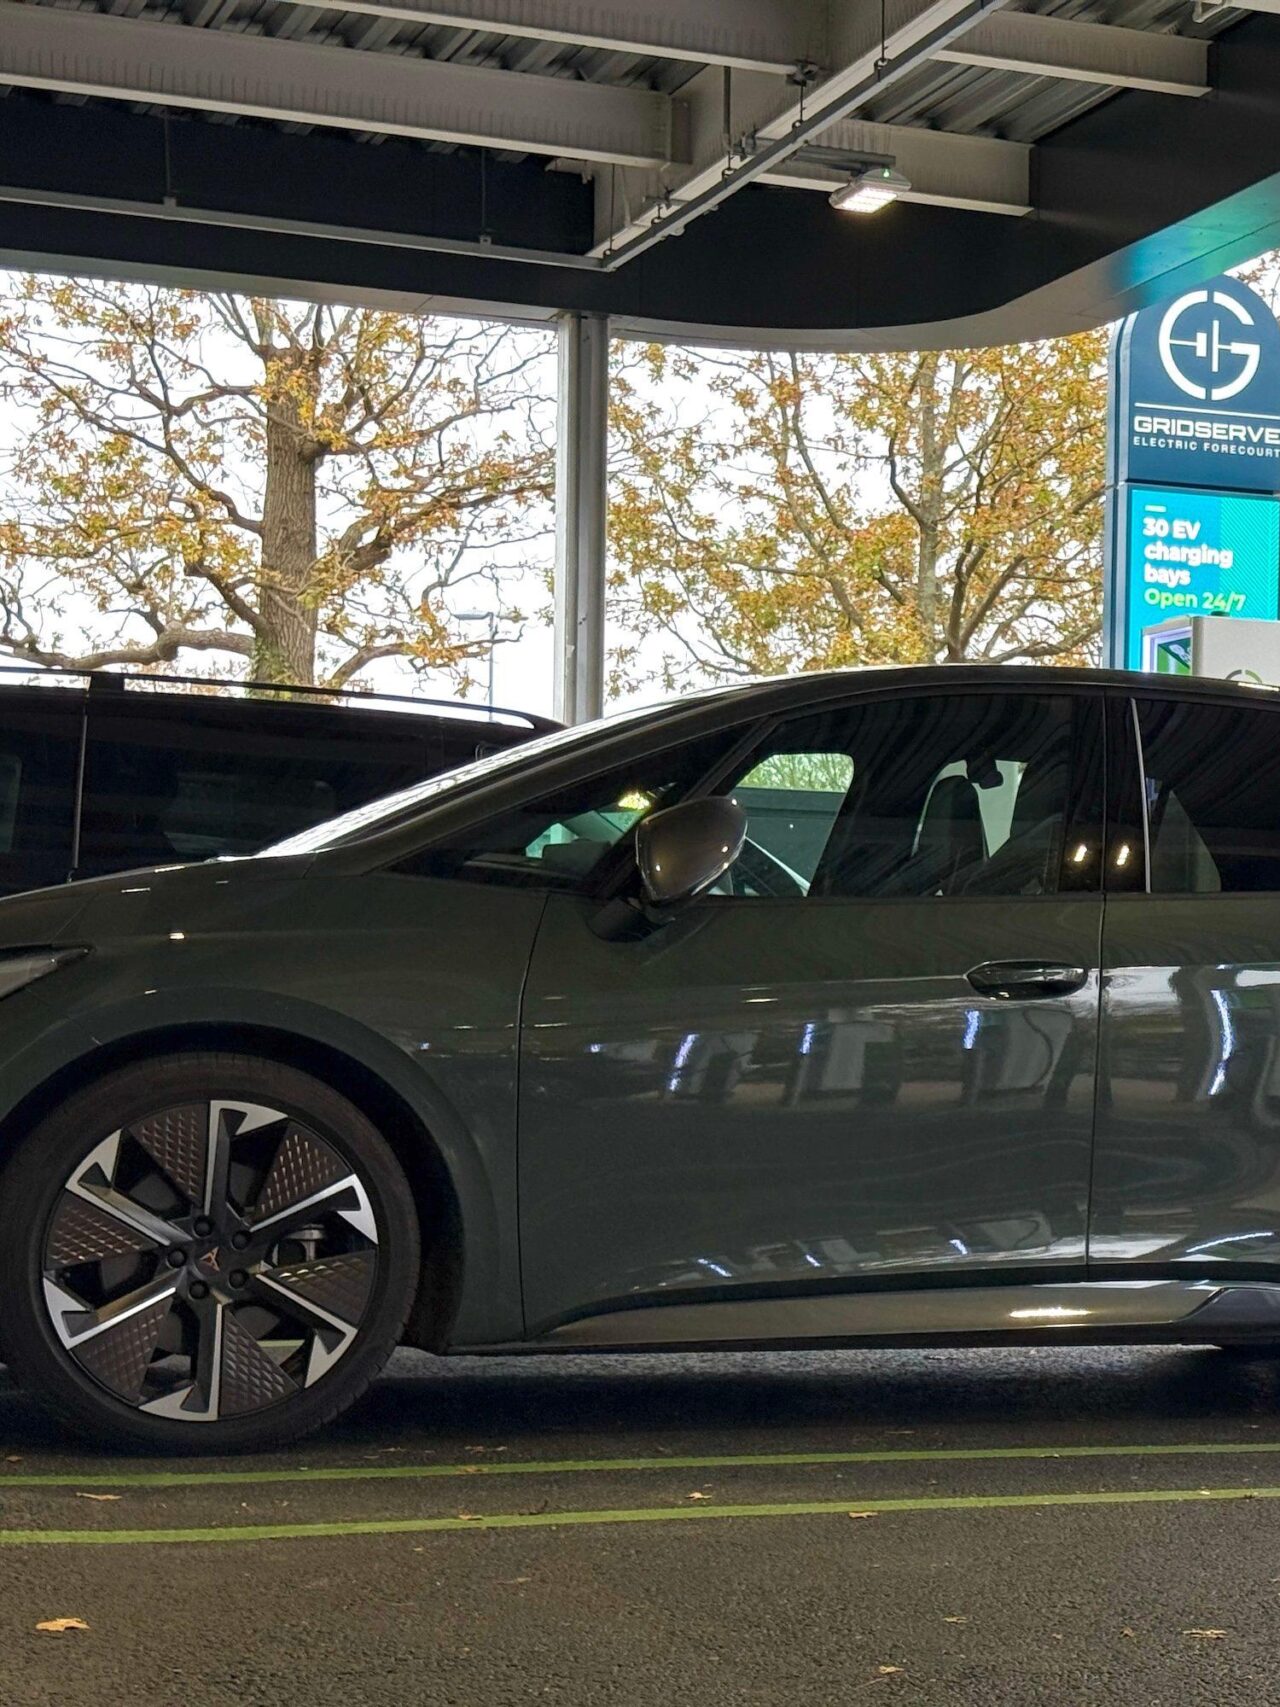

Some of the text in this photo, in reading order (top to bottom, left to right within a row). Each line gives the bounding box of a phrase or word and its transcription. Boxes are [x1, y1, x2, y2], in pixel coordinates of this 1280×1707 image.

[1134, 416, 1280, 445] GRIDSERVE
[1133, 437, 1280, 458] ELECTRIC FORECOURT
[1143, 517, 1201, 541] 30 EV
[1144, 542, 1234, 569] charging
[1144, 563, 1191, 588] bays
[1144, 588, 1246, 612] Open 24/7
